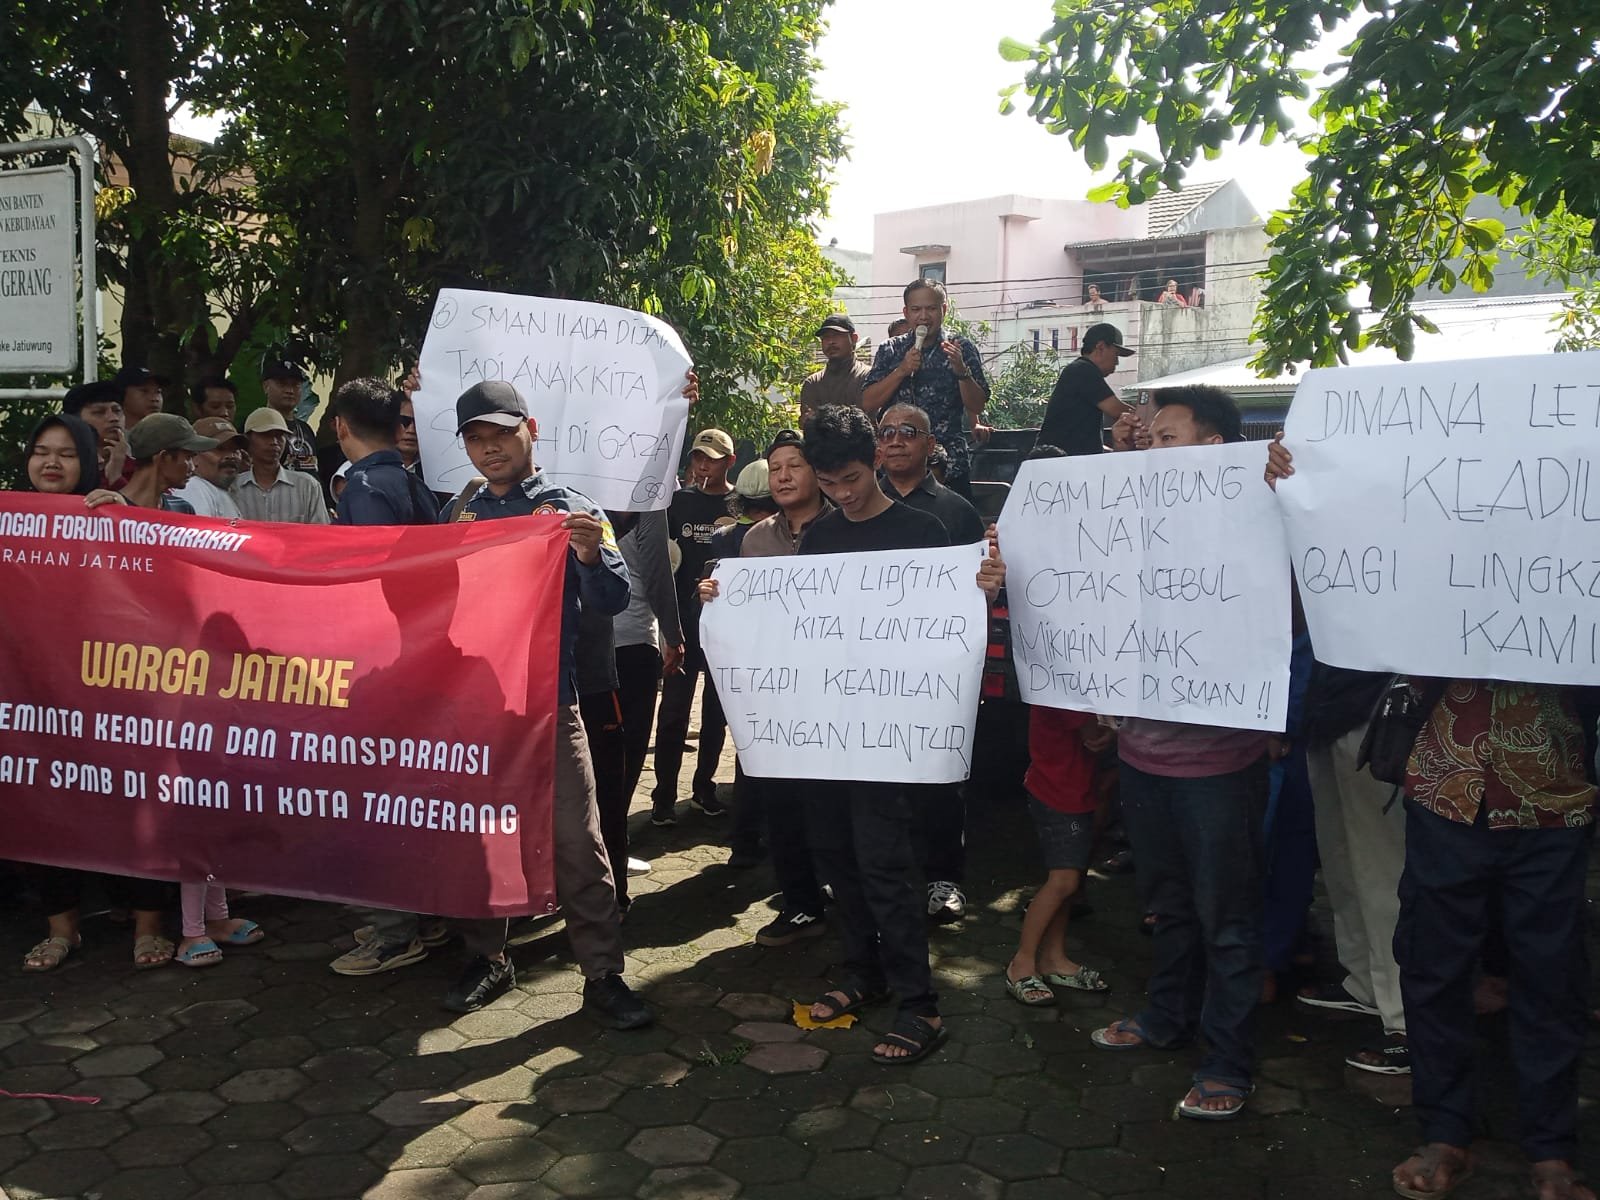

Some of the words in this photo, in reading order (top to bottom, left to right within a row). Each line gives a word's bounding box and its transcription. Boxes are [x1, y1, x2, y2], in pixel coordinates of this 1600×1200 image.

[13, 194, 45, 210] BANTEN
[5, 214, 56, 233] KEBUDAYAAN
[0, 248, 36, 263] EKNIS
[0, 267, 52, 297] GERANG
[465, 304, 547, 335] SMAN
[570, 317, 608, 342] ADA
[12, 339, 52, 354] Jatiuwung
[511, 355, 584, 394] ANAK
[1306, 382, 1486, 441] DIMANA
[597, 425, 672, 460] GAZA
[1021, 480, 1090, 516] ASAM
[1101, 465, 1248, 510] LAMBUNG
[1402, 455, 1600, 523] KEADIL
[0, 512, 48, 538] NGAN
[52, 515, 115, 542] FORUM
[119, 519, 252, 551] MASYARAKAT
[1078, 516, 1170, 561] NAIK
[3, 548, 70, 567] RAHAN
[79, 553, 154, 572] JATAKE
[1302, 546, 1397, 594] BAGI
[727, 562, 845, 614] BIARKAN
[860, 560, 959, 607] LIPSTIK
[1026, 567, 1127, 608] OTAK
[793, 615, 844, 641] KITA
[859, 616, 970, 652] LUNTUR
[1115, 619, 1202, 668] ANAK
[1461, 609, 1597, 664] KAMI
[81, 640, 210, 696] WARGA
[218, 653, 354, 708] JATAKE
[716, 667, 799, 693] TETAPI
[824, 668, 961, 704] KEADILAN
[1171, 675, 1245, 707] SMAN
[0, 702, 84, 738] EMINTA
[94, 712, 214, 752] KEADILAN
[225, 725, 277, 759] DAN
[290, 731, 490, 776] TRANSPARANSI
[736, 713, 850, 752] JANGAN
[862, 721, 969, 775] LUNTUR
[0, 755, 39, 785] AIT
[50, 760, 113, 795] SPMB
[124, 769, 147, 800] DI
[157, 774, 229, 809] SMAN
[243, 783, 263, 813] 11
[278, 786, 348, 819] KOTA
[363, 791, 518, 835] TANGERANG
